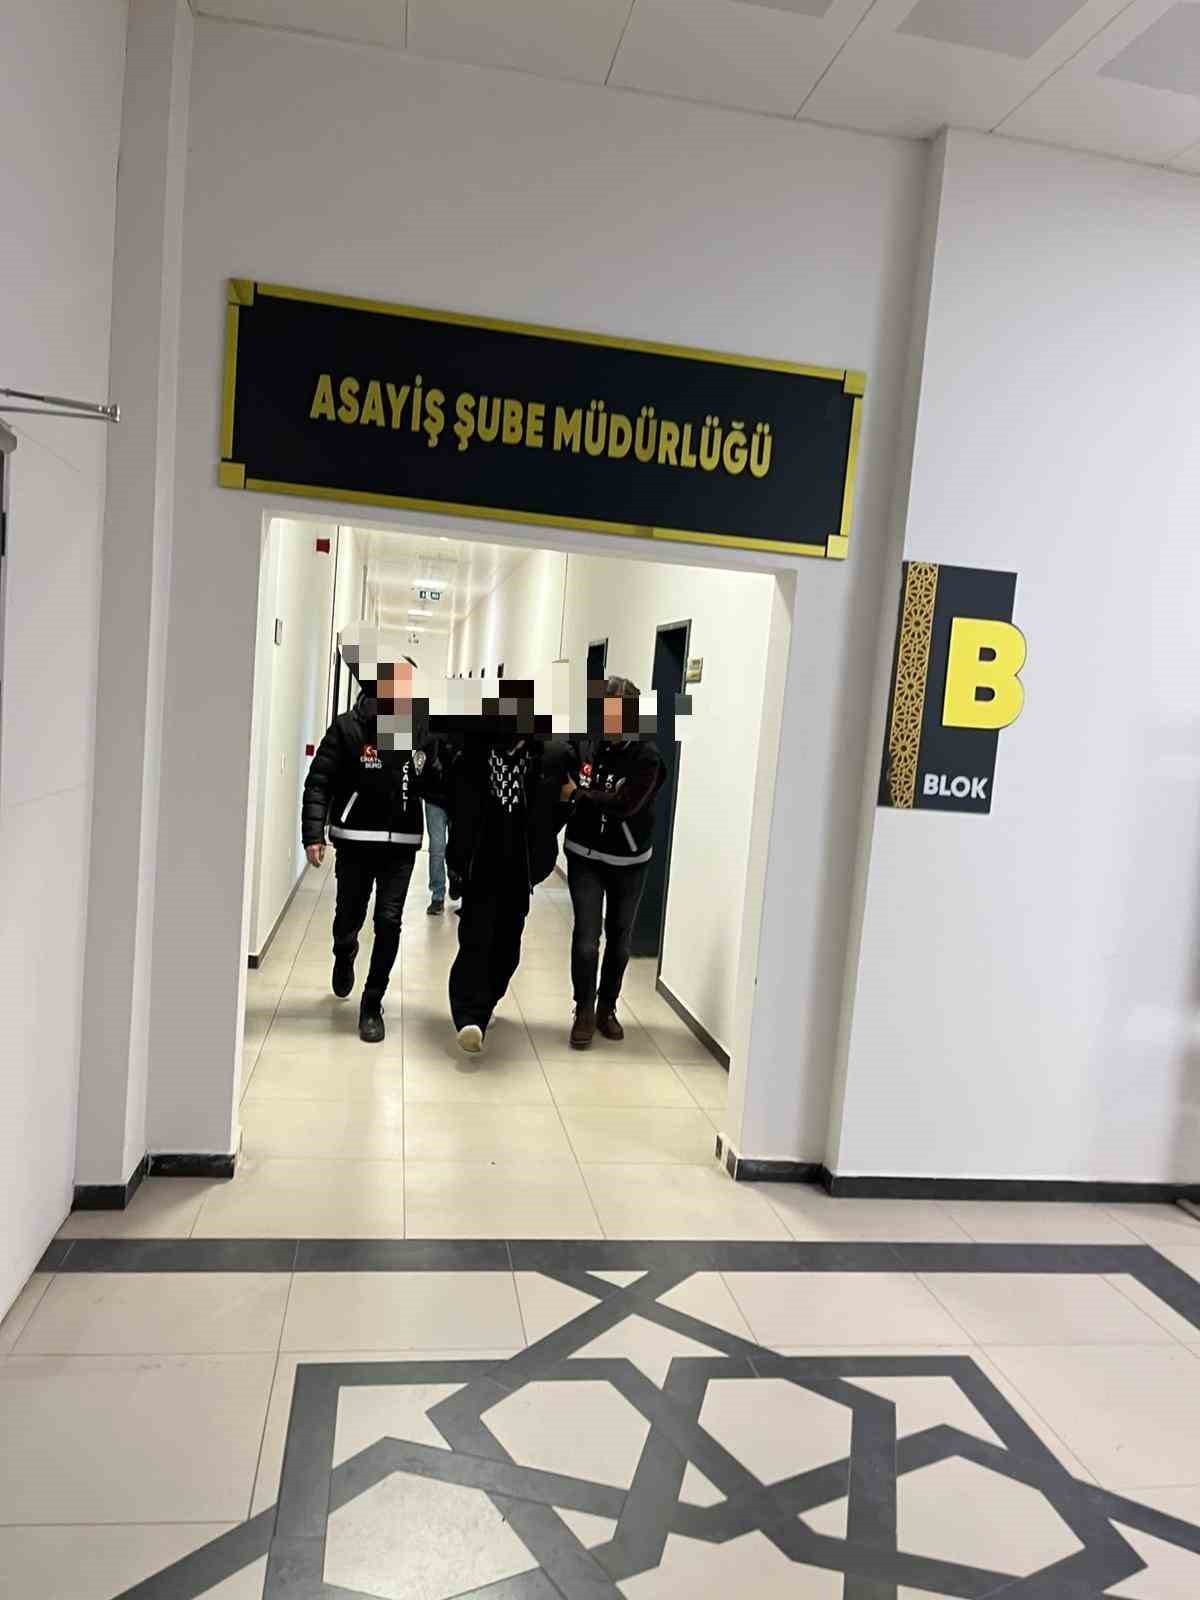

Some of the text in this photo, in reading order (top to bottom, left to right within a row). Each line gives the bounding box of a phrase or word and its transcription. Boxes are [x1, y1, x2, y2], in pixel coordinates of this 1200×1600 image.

[309, 374, 774, 479] ASAYİŞ ŞUBE MÜDÜRLÜĞÜ
[942, 616, 1027, 730] B
[923, 773, 989, 801] BLOK
